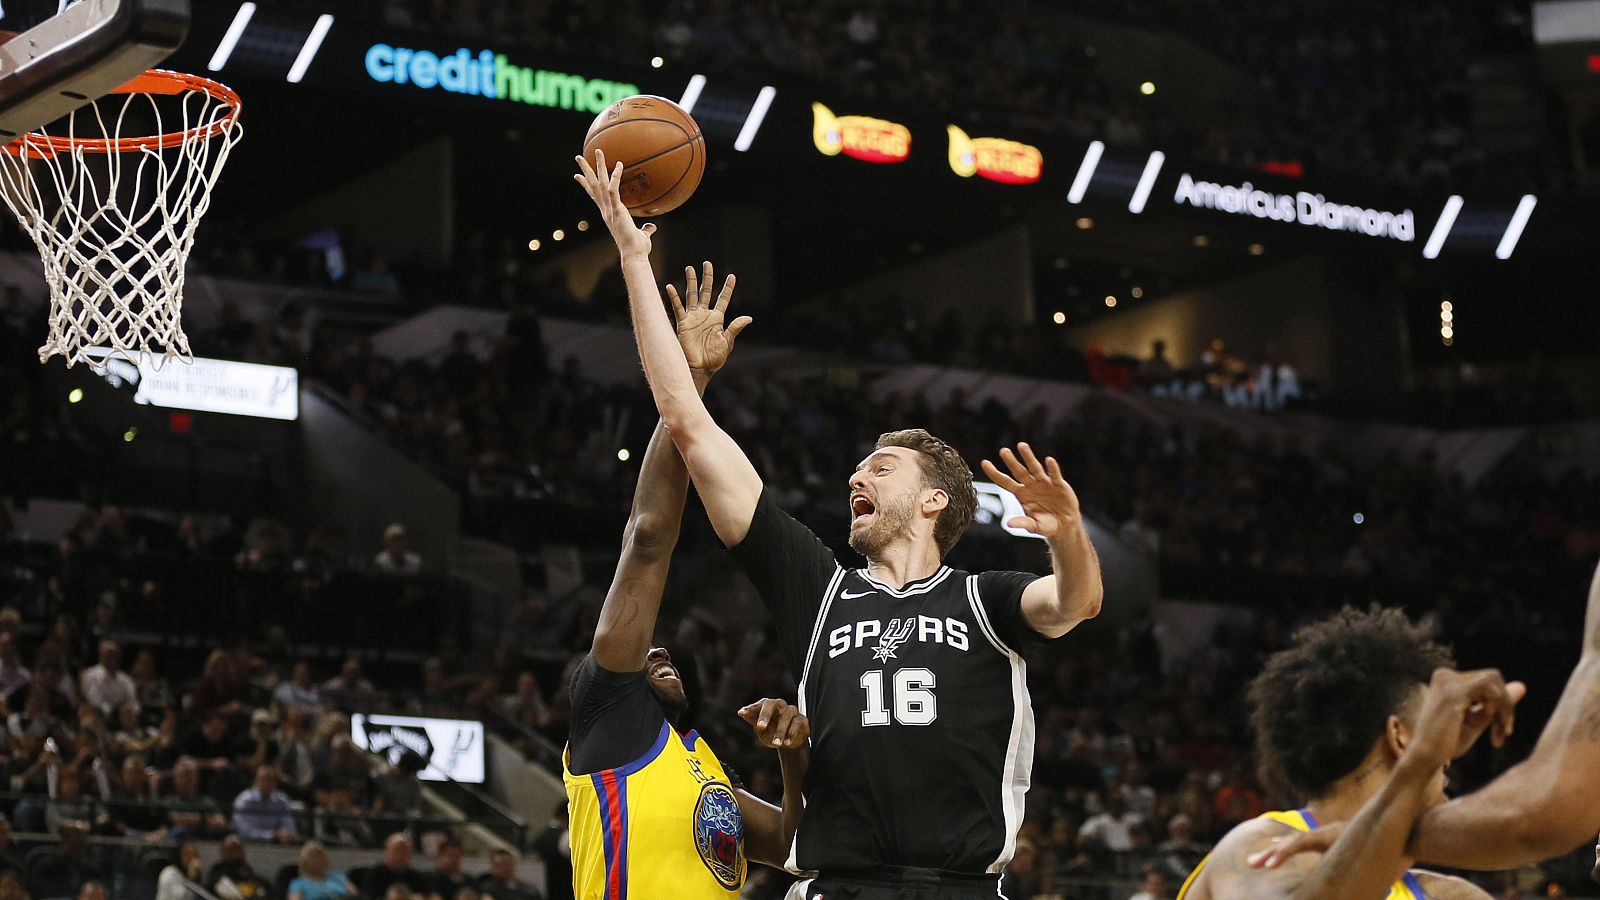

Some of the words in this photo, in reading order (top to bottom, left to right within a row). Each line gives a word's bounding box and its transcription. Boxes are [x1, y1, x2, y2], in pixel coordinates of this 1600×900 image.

[1174, 173, 1296, 223] Americus
[1296, 191, 1415, 241] Diamond
[829, 614, 969, 662] SPURS
[859, 667, 938, 727] 16
